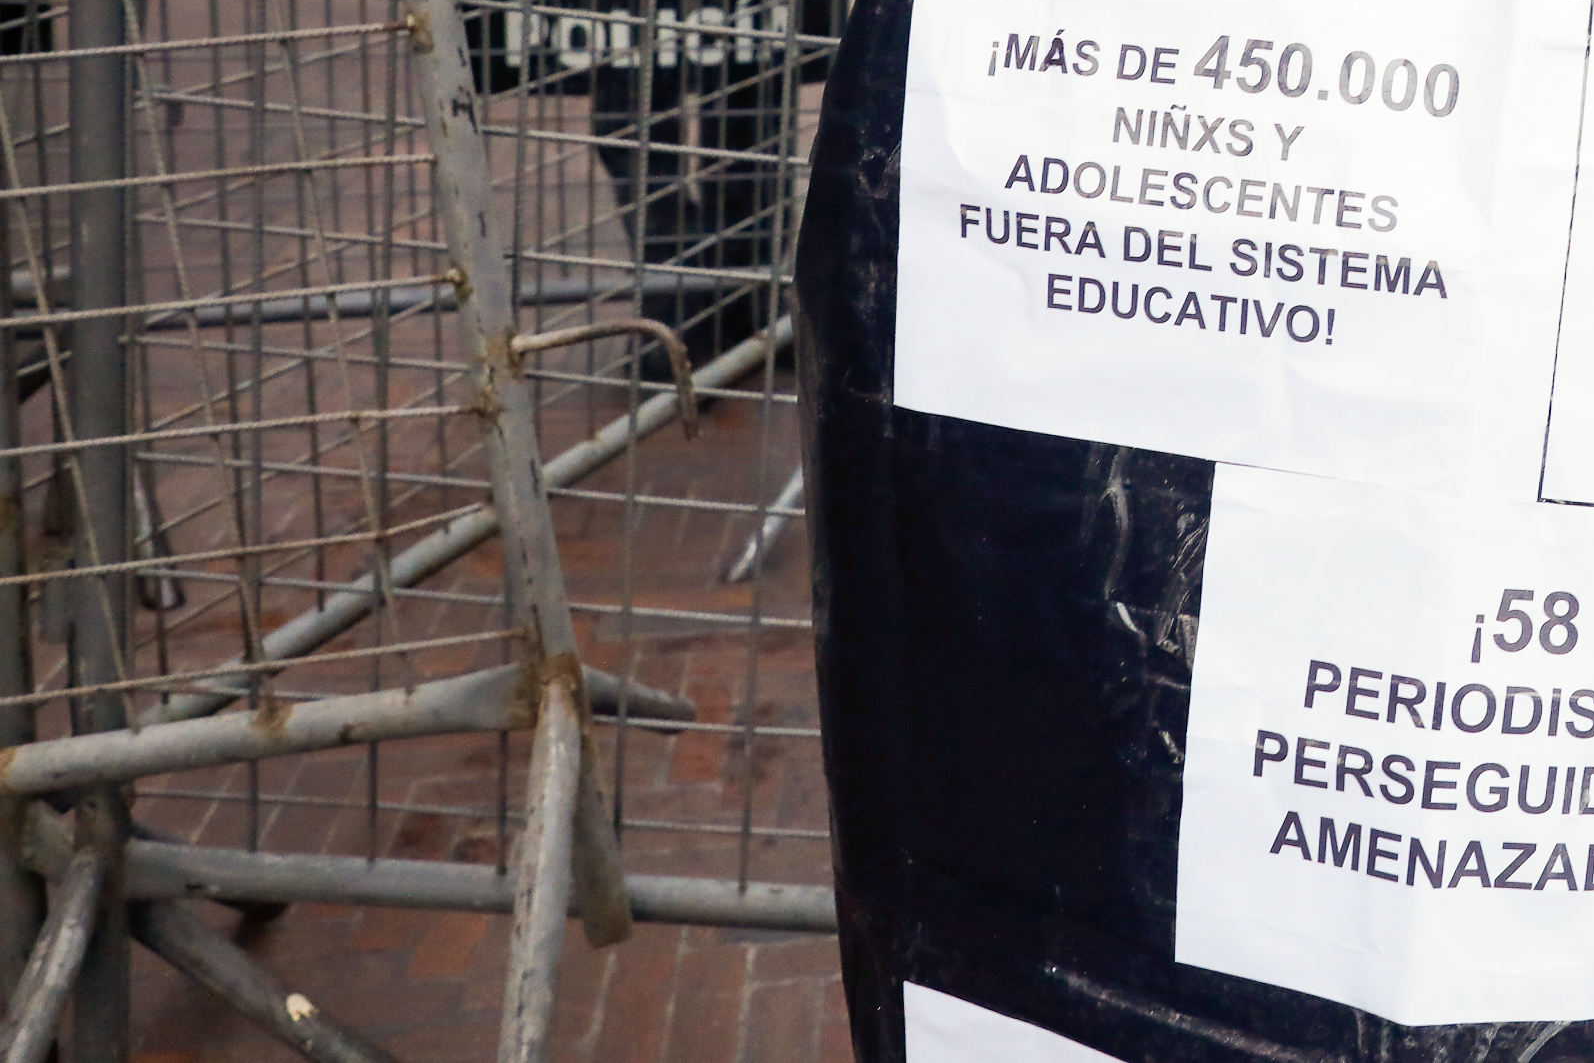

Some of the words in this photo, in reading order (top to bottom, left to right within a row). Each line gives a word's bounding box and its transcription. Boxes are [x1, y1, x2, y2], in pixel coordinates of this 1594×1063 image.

[988, 29, 1100, 76] ¡MÁS
[1117, 44, 1179, 84] DE
[1194, 35, 1459, 117] 450.000
[1113, 104, 1254, 157] NIÑXS
[1275, 124, 1304, 161] Y
[1004, 154, 1397, 232] ADOLESCENTES
[960, 203, 1106, 258] FUERA
[1123, 226, 1212, 272] DEL
[1230, 239, 1447, 299] SISTEMA
[1047, 273, 1335, 345] EDUCATIVO!
[1471, 589, 1579, 663] ¡58
